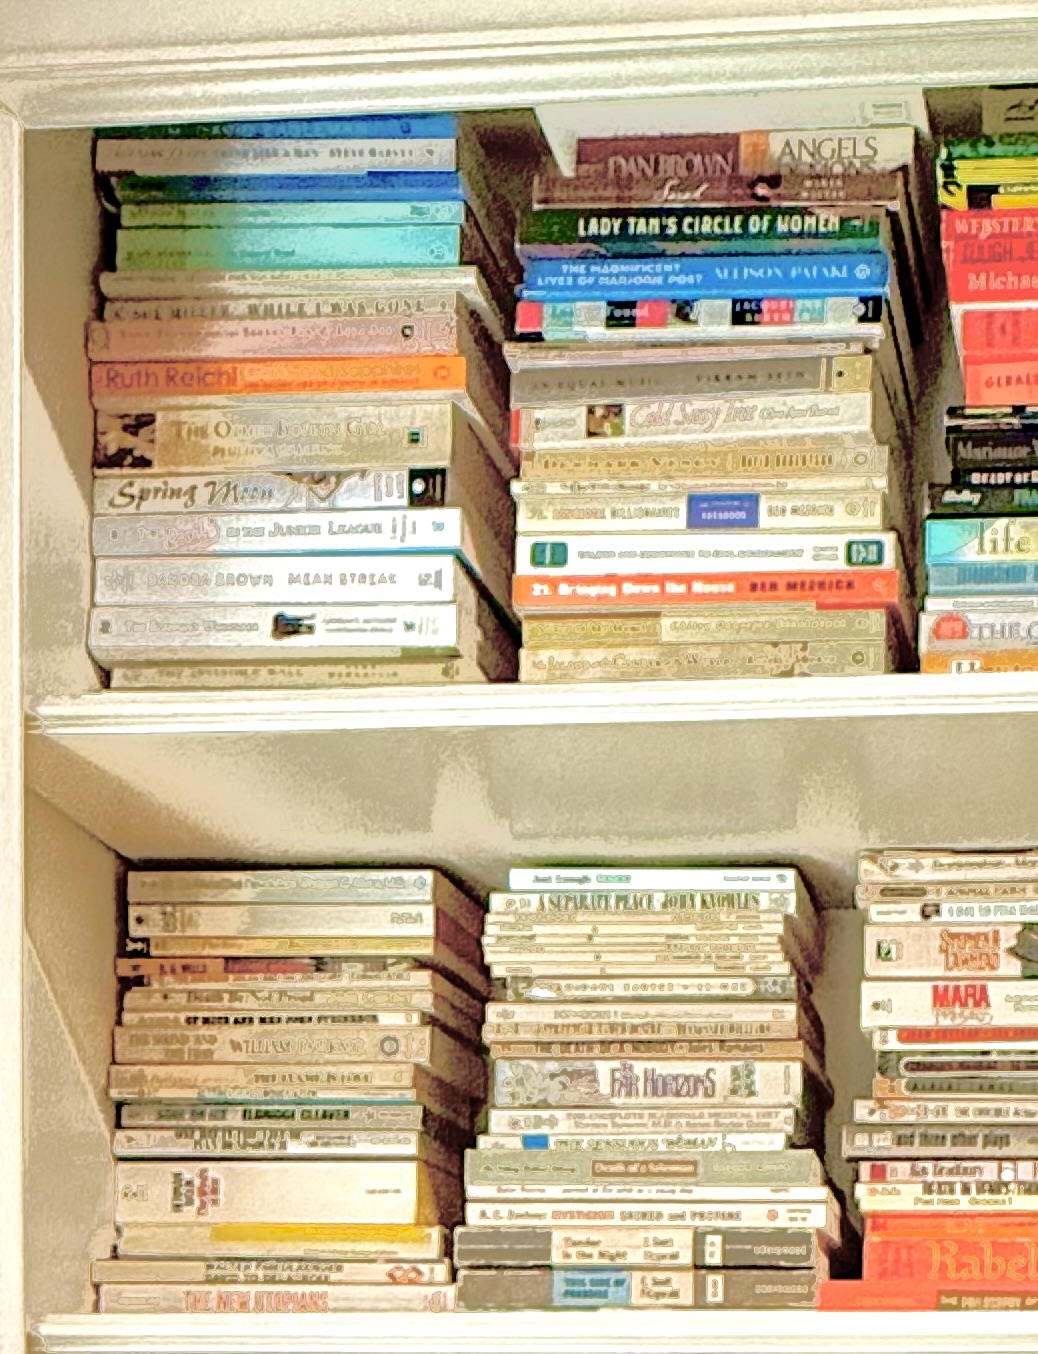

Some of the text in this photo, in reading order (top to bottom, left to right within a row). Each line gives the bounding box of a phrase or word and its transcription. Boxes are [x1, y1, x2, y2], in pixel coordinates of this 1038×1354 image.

[779, 136, 878, 160] ANGELS
[657, 153, 734, 176] BROWN
[578, 214, 840, 237] LADY TAN'S CIRCLE OF WOMEN
[106, 368, 158, 389] Ruth
[108, 482, 198, 510] Spring
[977, 519, 1030, 555] life
[215, 572, 274, 587] BROWN
